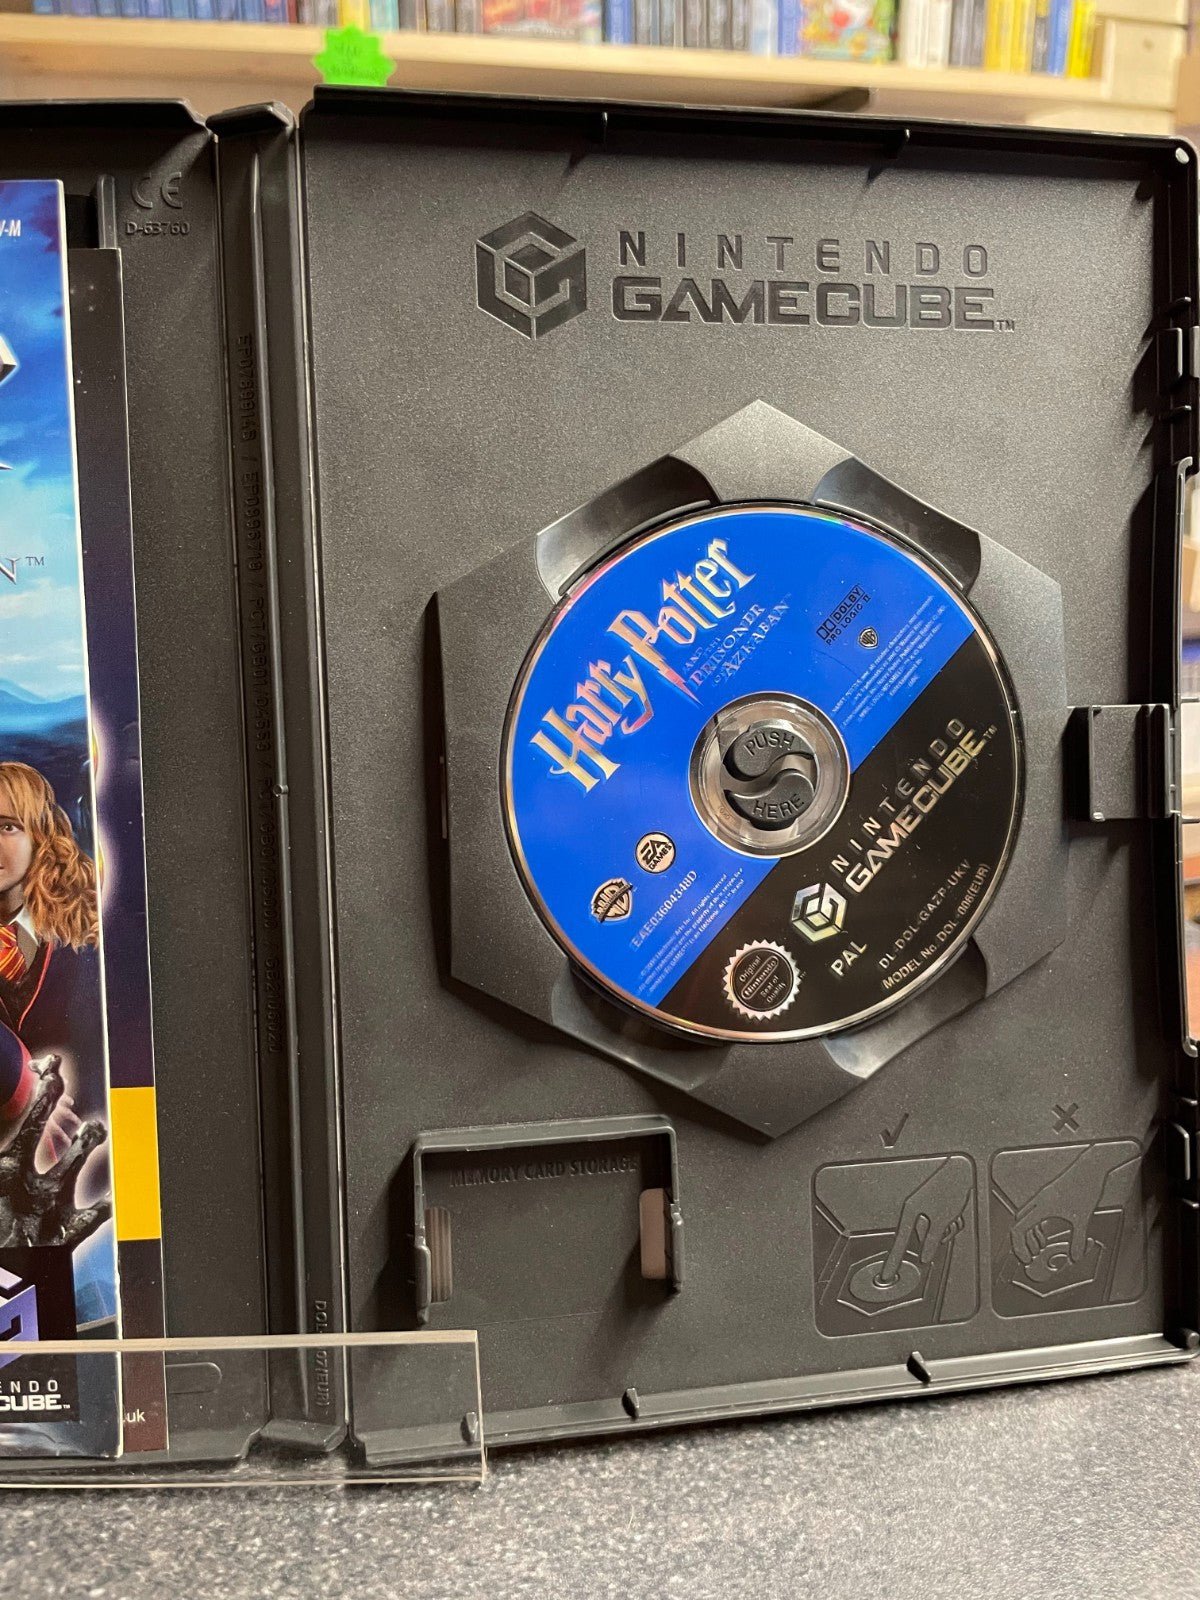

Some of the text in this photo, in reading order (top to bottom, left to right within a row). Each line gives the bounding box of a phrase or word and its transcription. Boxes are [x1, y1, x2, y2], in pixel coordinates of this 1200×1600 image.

[126, 221, 190, 235] D-63760
[618, 230, 988, 279] NINTENDO
[611, 276, 995, 332] GAMECUBE
[832, 587, 862, 620] DOLBY
[723, 600, 790, 677] AZKABAN
[825, 627, 842, 645] PRO
[840, 602, 864, 628] LOGIC
[690, 604, 766, 686] PRISONER
[530, 538, 756, 793] Harry Potter
[744, 732, 795, 756] PUSH
[752, 794, 802, 820] HERE
[831, 718, 966, 873] NINTENDO
[845, 728, 986, 894] GAMECUBE
[648, 842, 673, 871] GAMES
[737, 955, 764, 984] Original
[830, 940, 868, 977] PAL
[882, 957, 918, 990] MODEL
[743, 958, 777, 997] Nintendo
[759, 981, 774, 997] Seal
[765, 980, 787, 1004] Quality
[450, 1154, 638, 1188] MEMORY CARD STORAGE
[314, 1300, 330, 1406] DOL-07(EUR)
[0, 1380, 58, 1393] NDO
